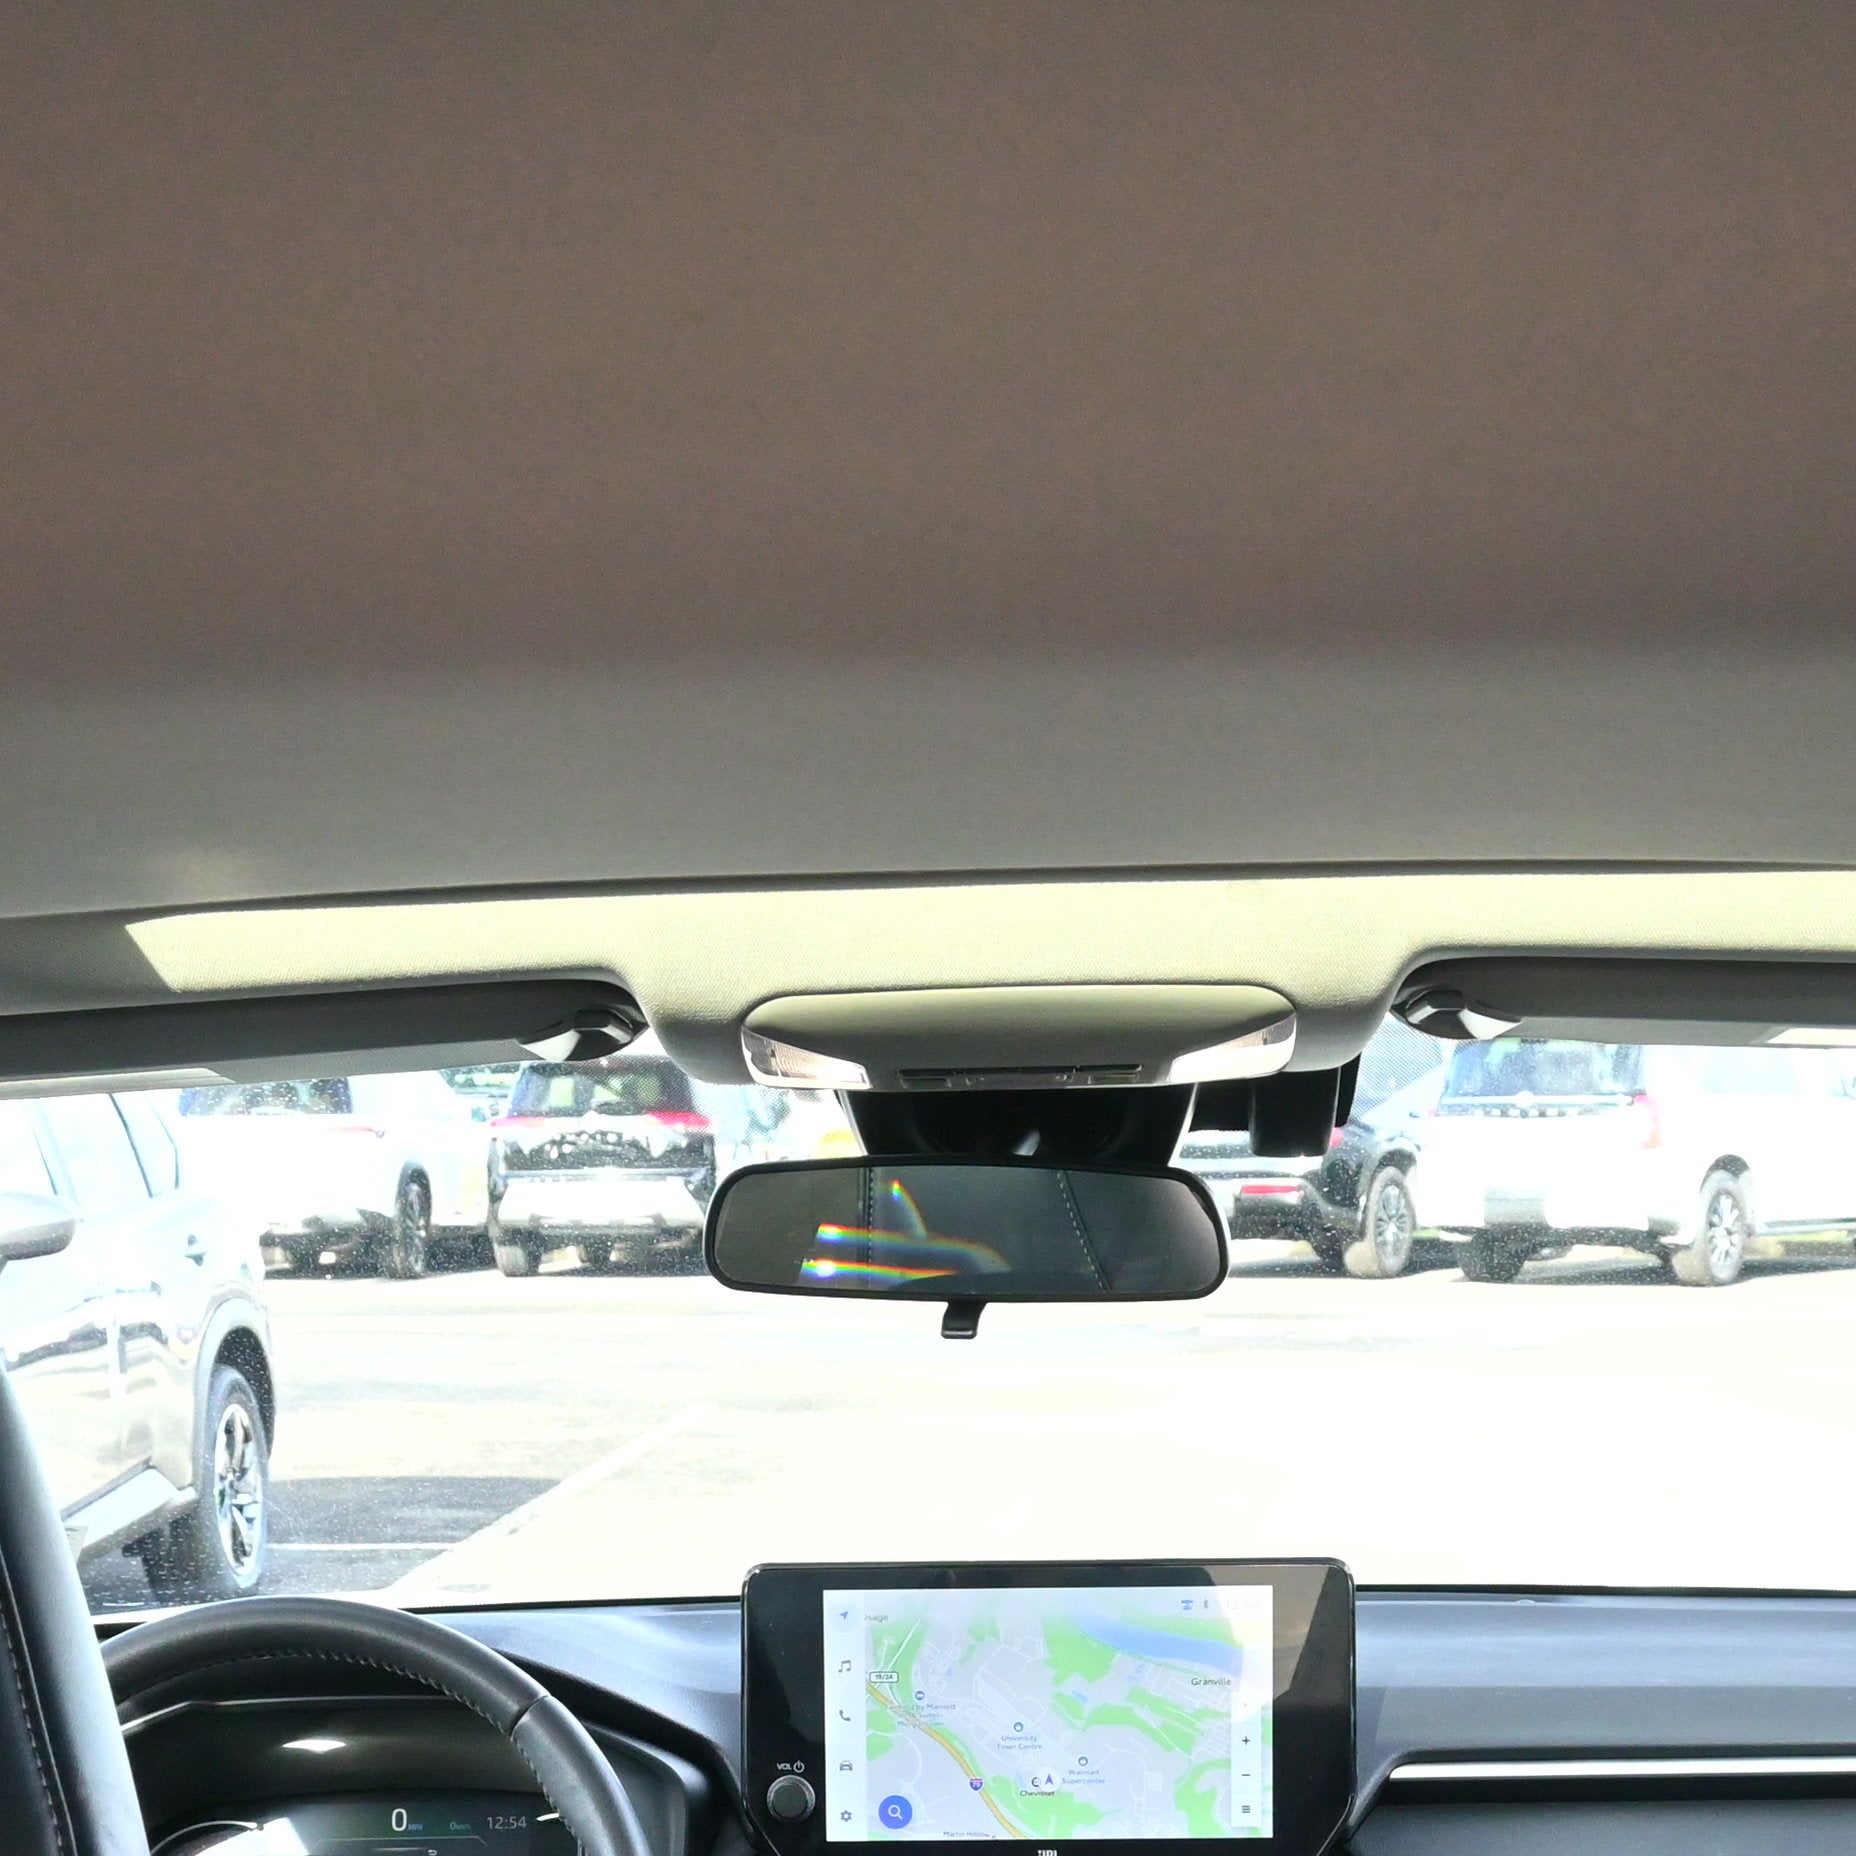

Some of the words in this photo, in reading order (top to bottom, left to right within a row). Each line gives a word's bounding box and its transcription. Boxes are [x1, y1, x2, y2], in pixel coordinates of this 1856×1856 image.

[1190, 1677, 1232, 1686] Granville
[1001, 1735, 1038, 1744] University
[391, 1808, 407, 1832] 0
[486, 1815, 528, 1830] 12:54
